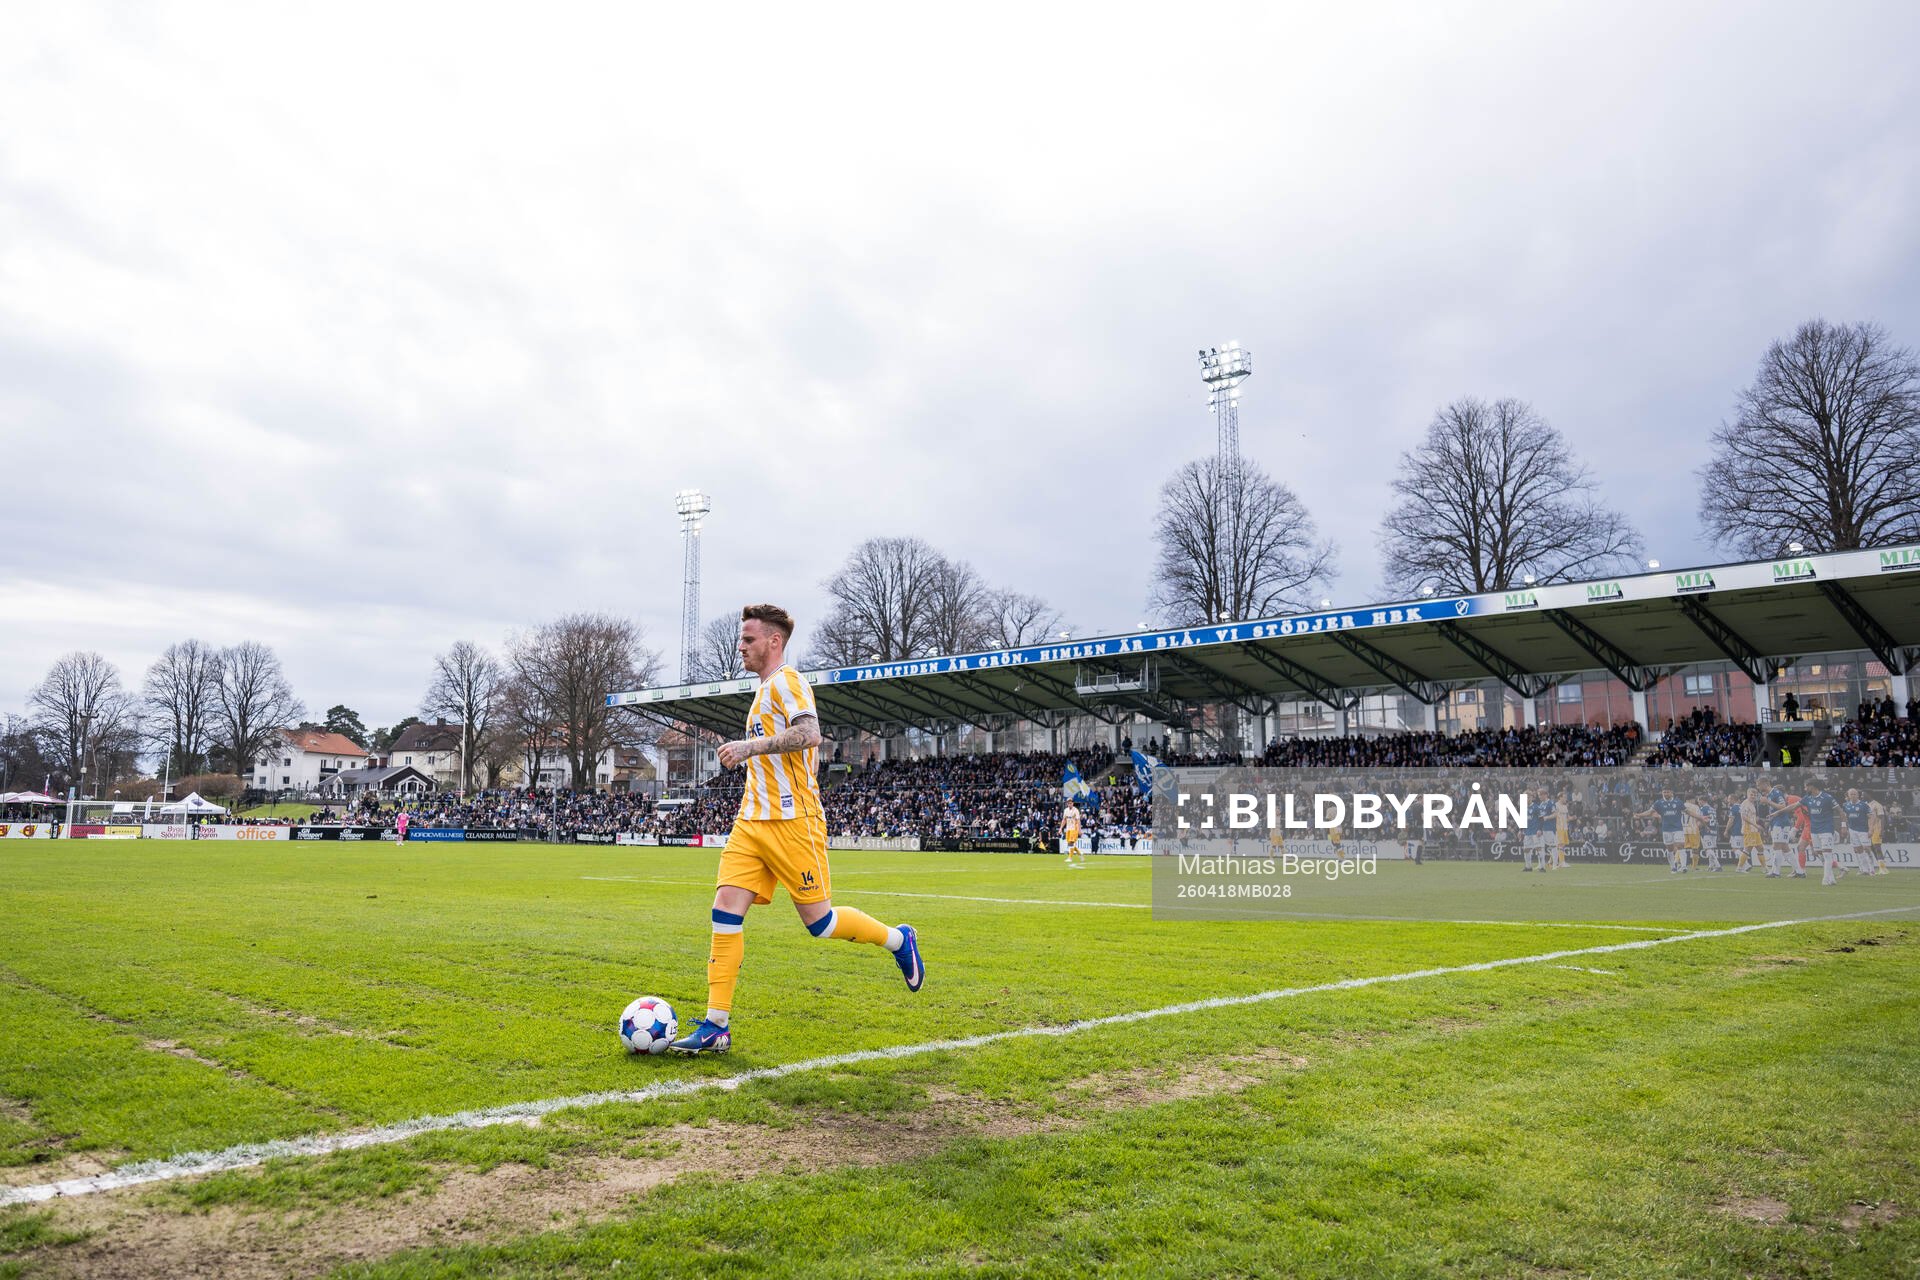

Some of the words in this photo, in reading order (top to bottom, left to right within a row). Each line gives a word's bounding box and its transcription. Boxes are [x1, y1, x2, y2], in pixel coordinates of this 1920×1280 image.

[857, 661, 939, 680] FRAMTIDEN
[949, 658, 968, 672] ÄR
[1040, 643, 1107, 661] HIMLEN
[1119, 638, 1144, 652] ÄR
[1216, 628, 1239, 642] VI
[1253, 617, 1355, 638] STÖDJER
[1372, 607, 1422, 626] HBK
[236, 827, 277, 840] office
[496, 831, 517, 839] MÅLERI
[1641, 848, 1669, 859] CITY
[801, 870, 814, 885] 14
